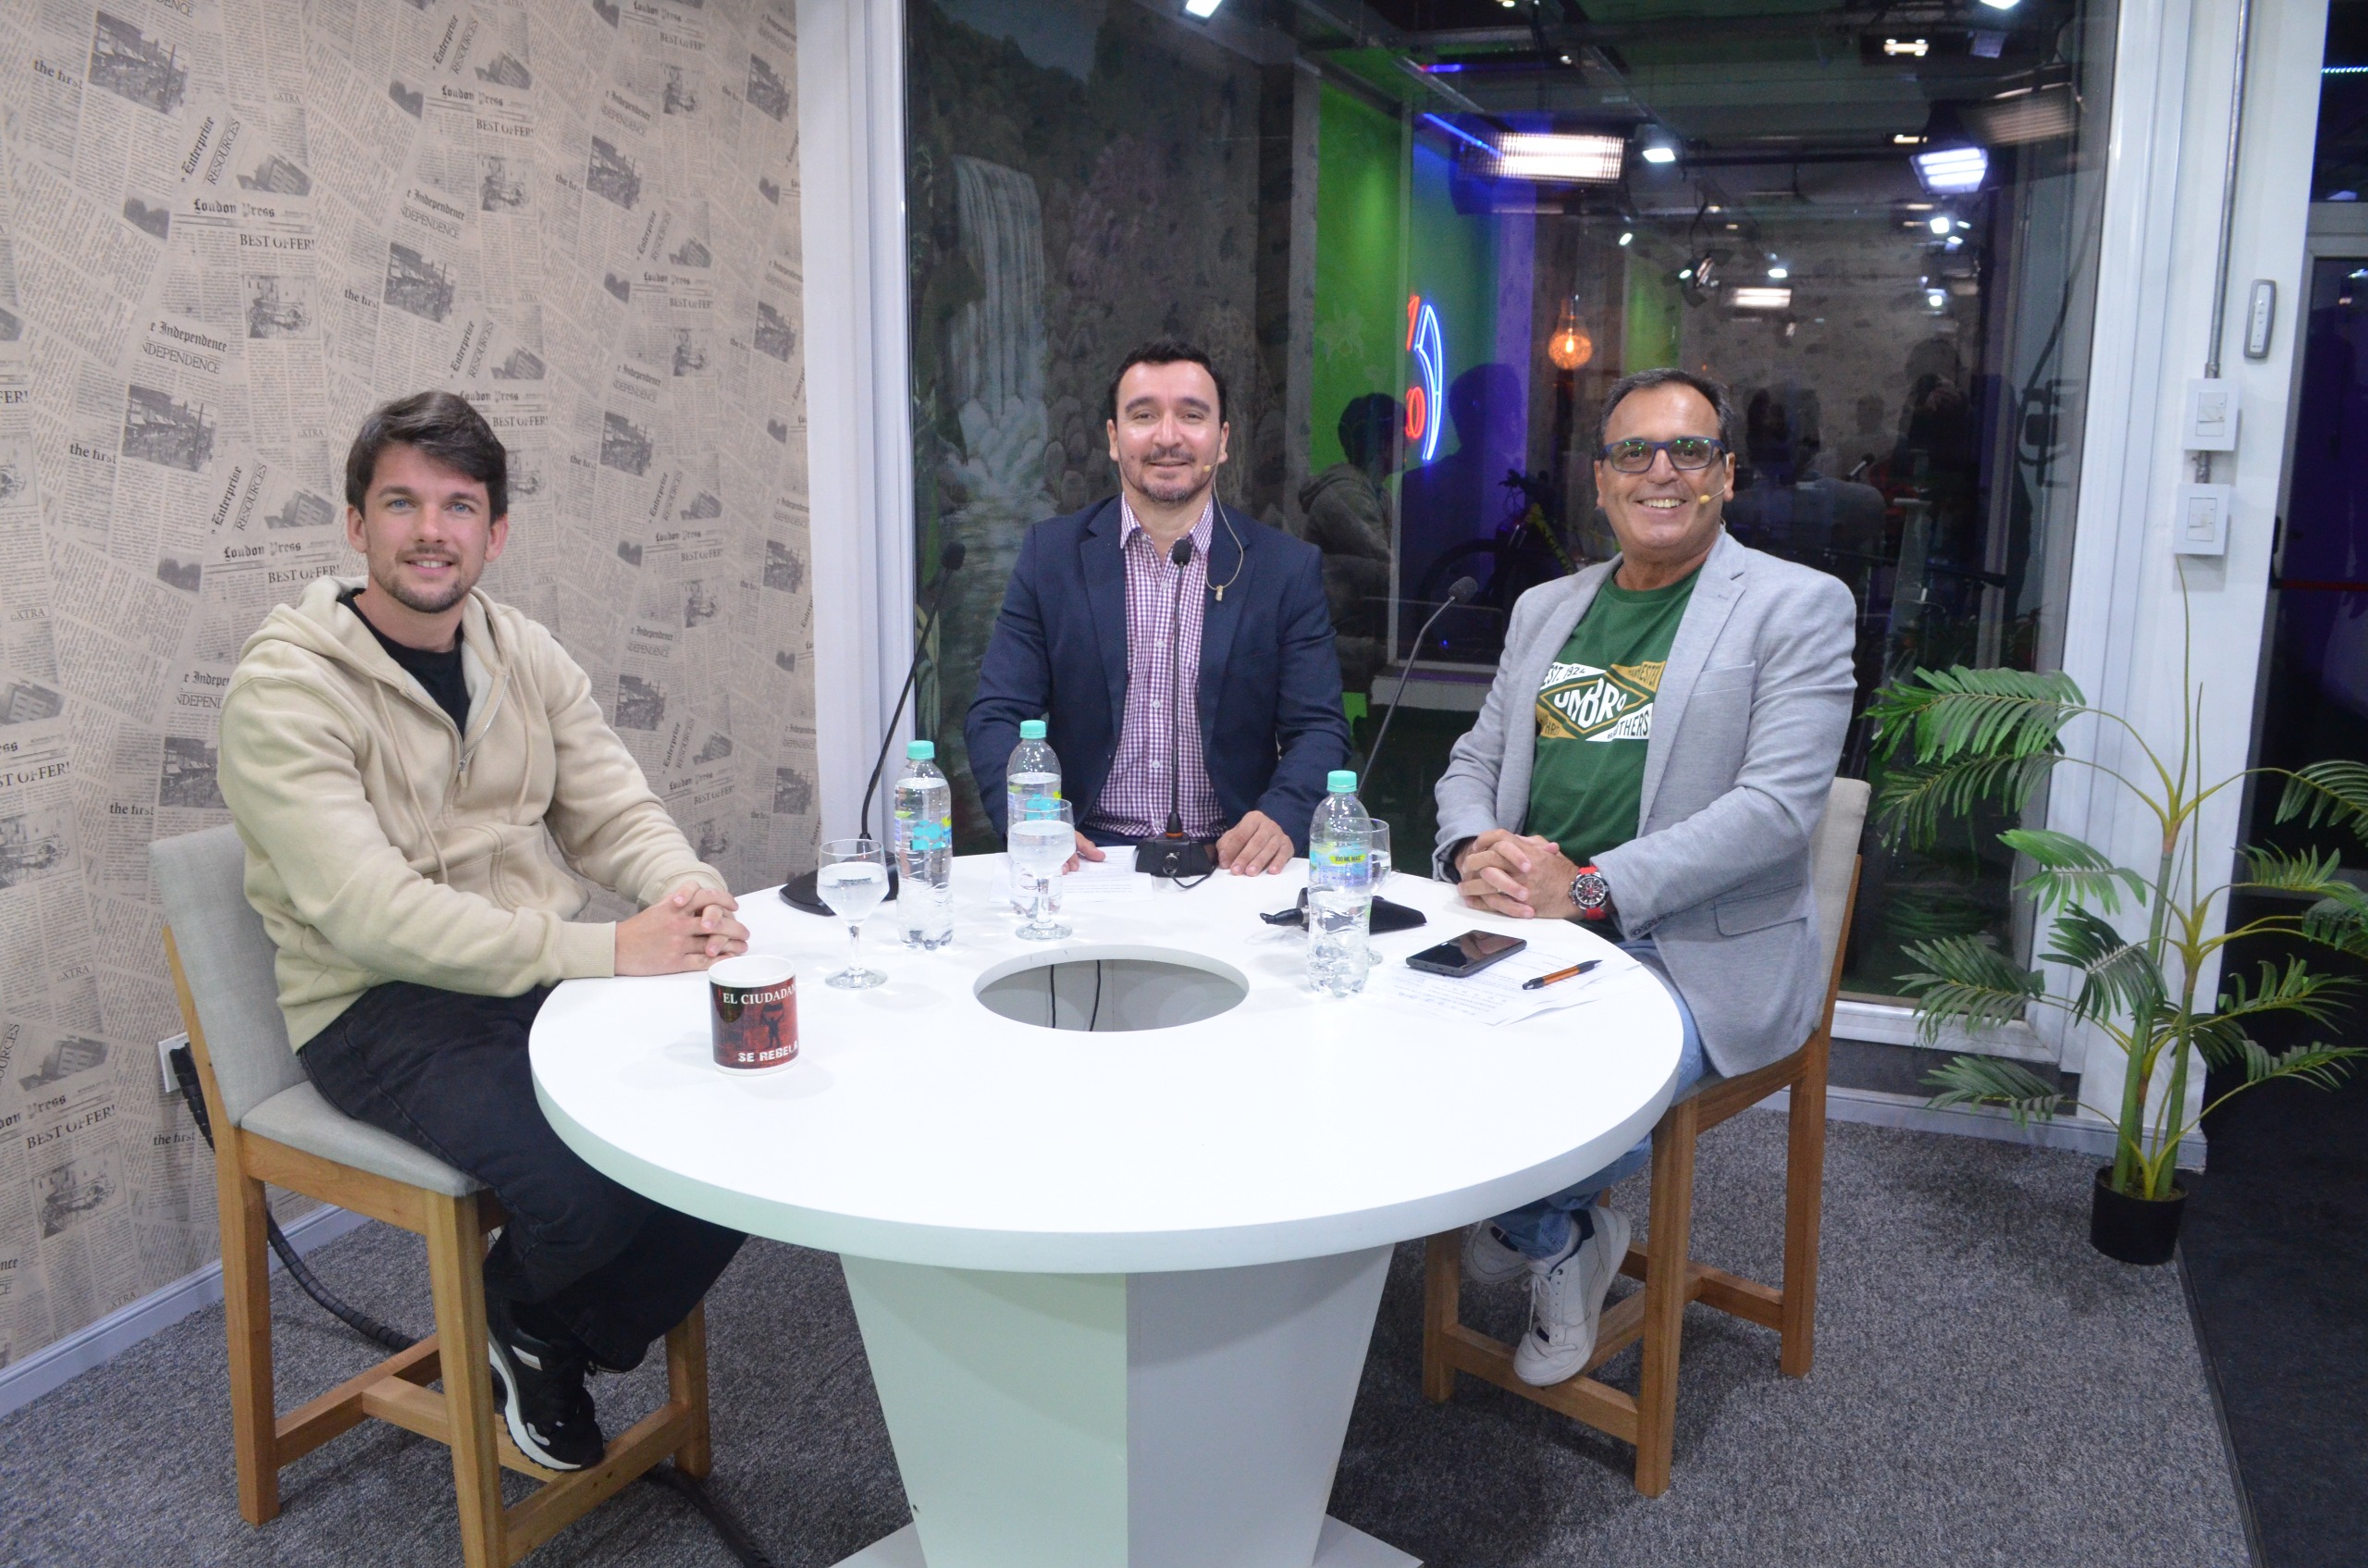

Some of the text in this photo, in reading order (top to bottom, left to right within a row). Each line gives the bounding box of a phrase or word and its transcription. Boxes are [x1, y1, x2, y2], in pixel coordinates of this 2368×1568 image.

[33, 58, 54, 78] the
[476, 118, 500, 133] BEST
[181, 116, 216, 177] Enterprise
[206, 118, 240, 185] RESOURCES
[192, 198, 238, 215] London
[241, 202, 276, 218] Press
[240, 233, 270, 248] BEST
[344, 288, 360, 303] the
[160, 320, 228, 353] Independence
[493, 416, 514, 427] BEST
[70, 442, 89, 457] the
[212, 465, 242, 526] Enterprise
[236, 463, 267, 532] RESOURCES
[224, 541, 302, 562] London Press
[268, 570, 297, 584] BEST
[1554, 677, 1627, 728] UMBRO
[110, 802, 128, 815] the
[722, 993, 738, 1005] EL
[738, 1041, 798, 1062] SE REBELA
[27, 1095, 68, 1119] Press
[27, 1124, 62, 1150] BEST
[154, 1132, 171, 1146] the
